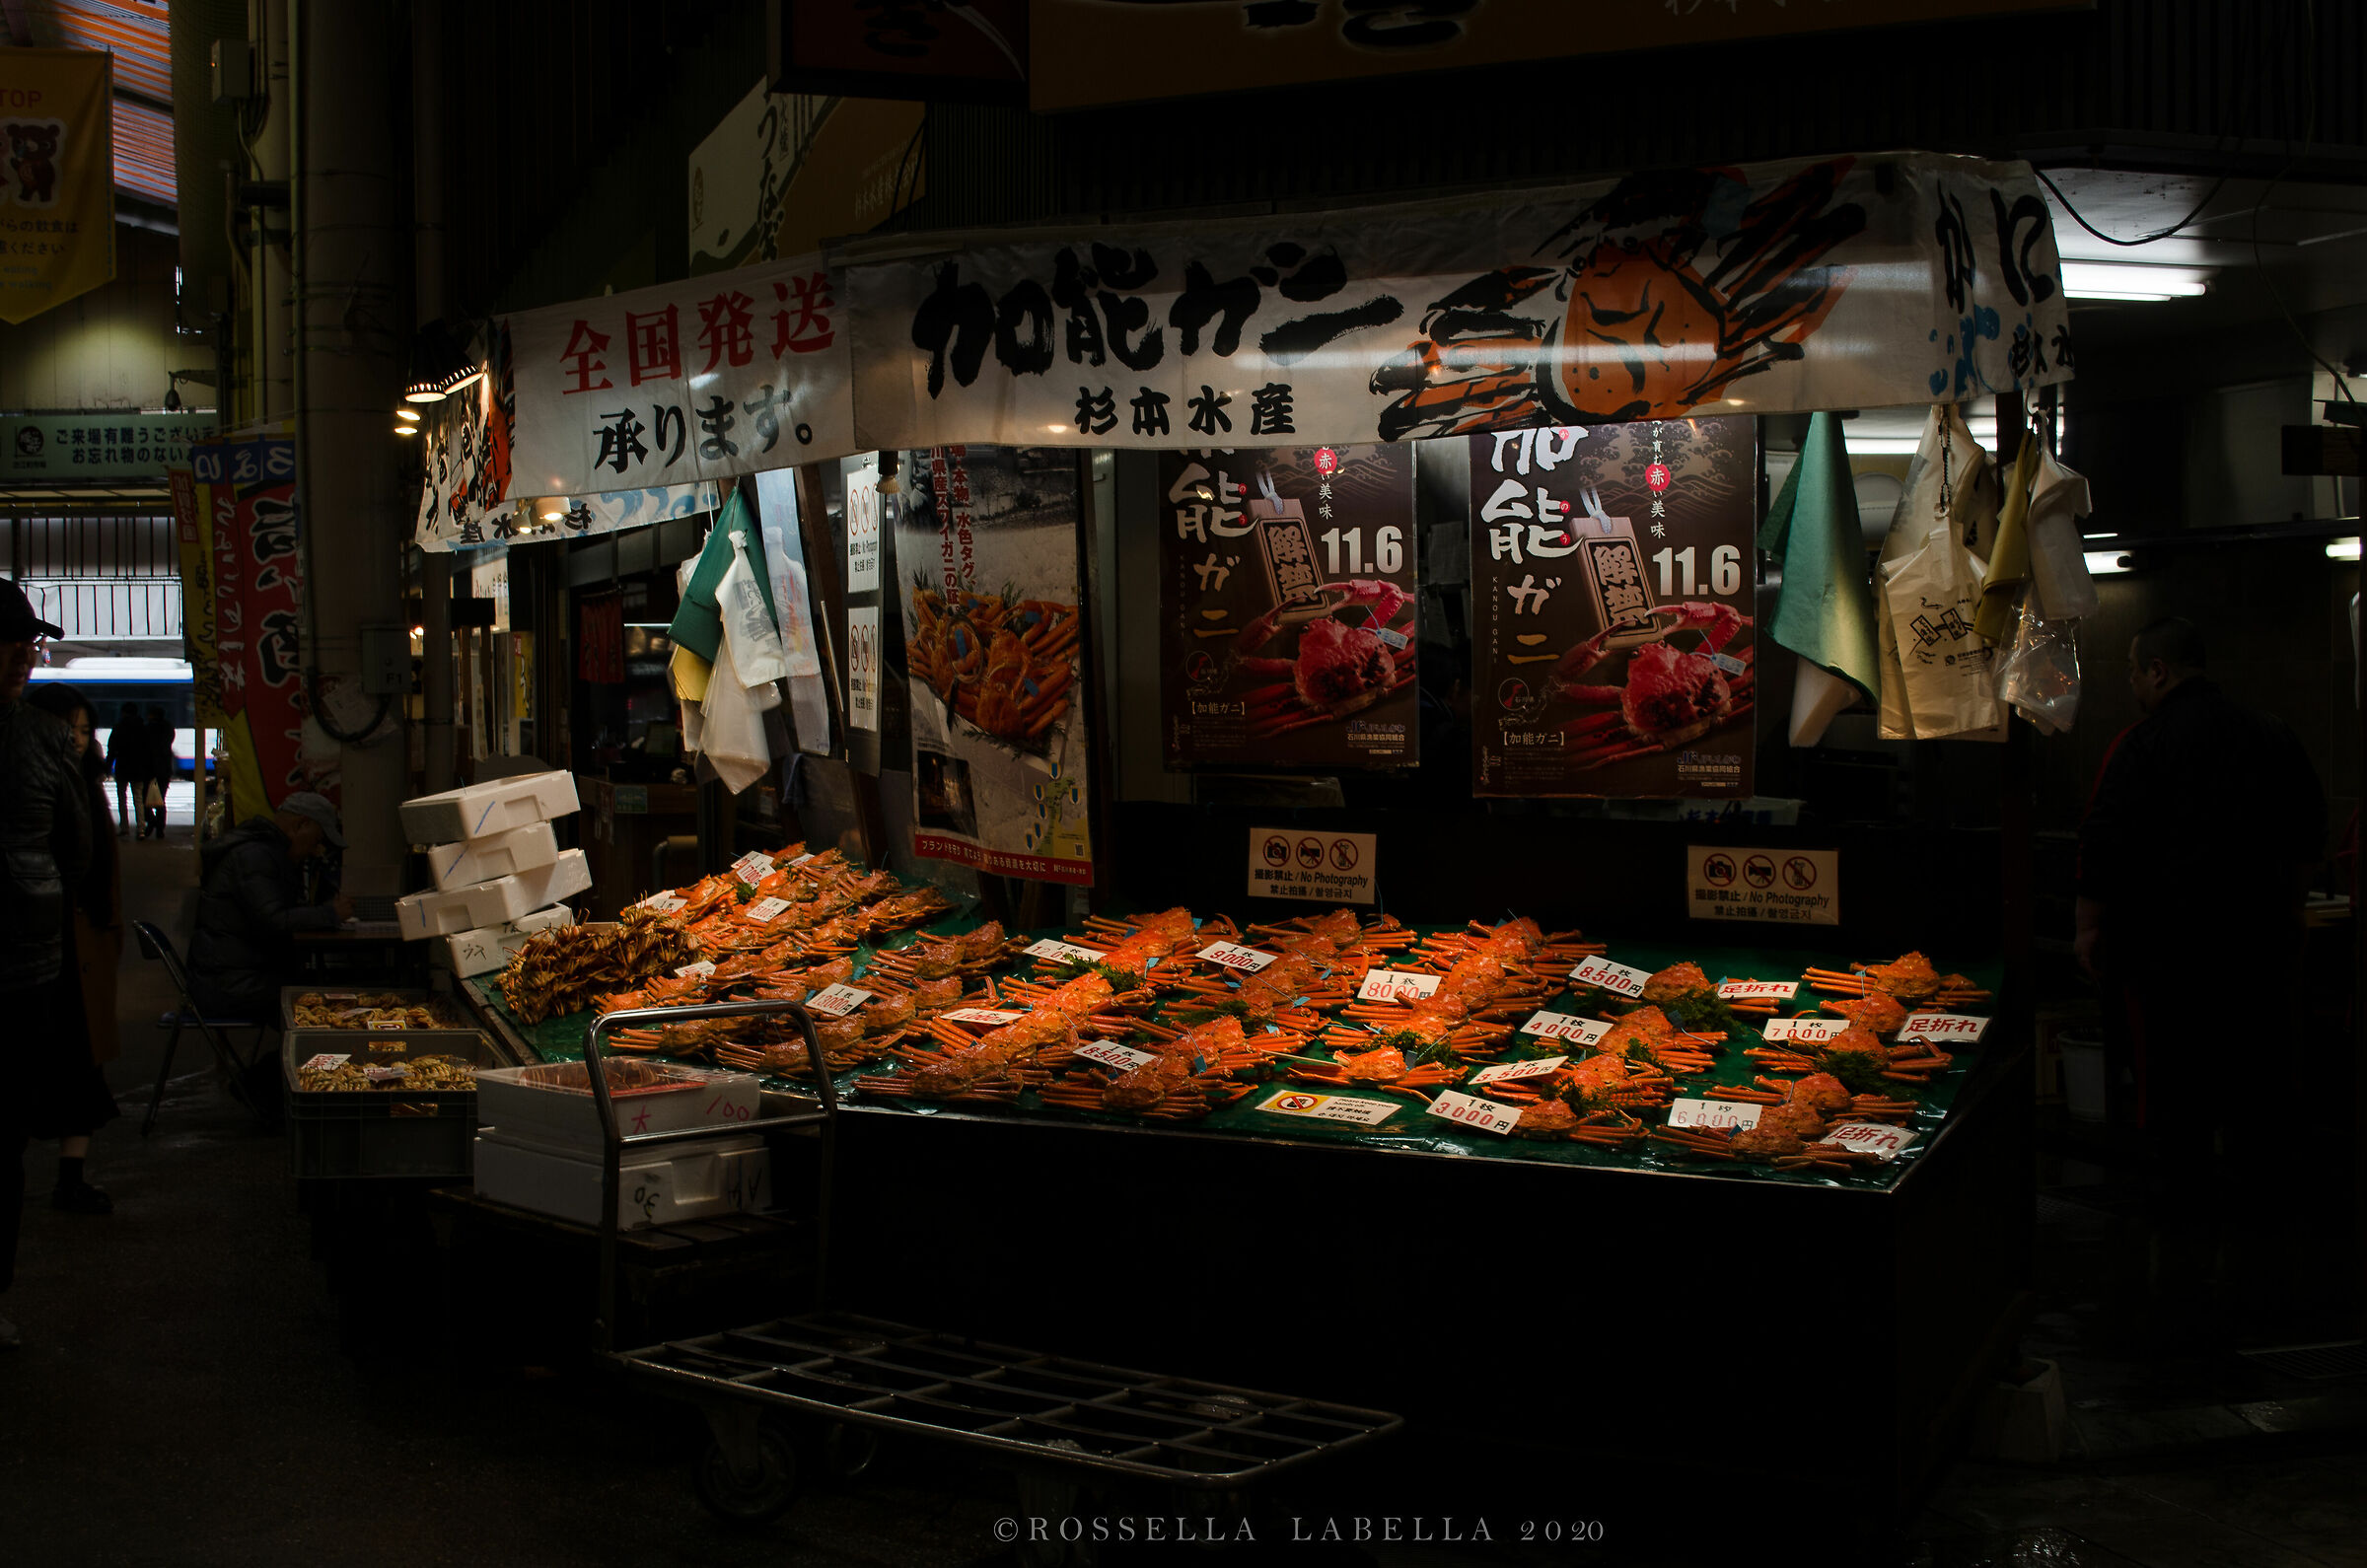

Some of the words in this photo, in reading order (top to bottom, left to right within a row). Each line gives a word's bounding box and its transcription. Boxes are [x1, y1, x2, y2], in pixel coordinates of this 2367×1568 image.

[559, 271, 835, 394] 全国発送
[912, 243, 1404, 398] 加能ガニ
[1075, 383, 1296, 436] 杉本水産
[593, 384, 813, 473] 承ります。
[1169, 449, 1259, 638] 能ガニ
[1321, 525, 1403, 574] 11.6
[1652, 544, 1741, 597] 11.6
[1301, 871, 1312, 883] No
[1315, 873, 1368, 889] Photography
[1750, 891, 1762, 903] No
[1765, 892, 1829, 908] Photography
[1578, 965, 1643, 994] 8.500円
[1603, 962, 1632, 977] 1枚
[1721, 983, 1792, 994] 足折れ
[1559, 1016, 1587, 1028] 1枚
[1904, 1018, 1977, 1033] 足折れ
[1828, 1126, 1900, 1150] 足折れ
